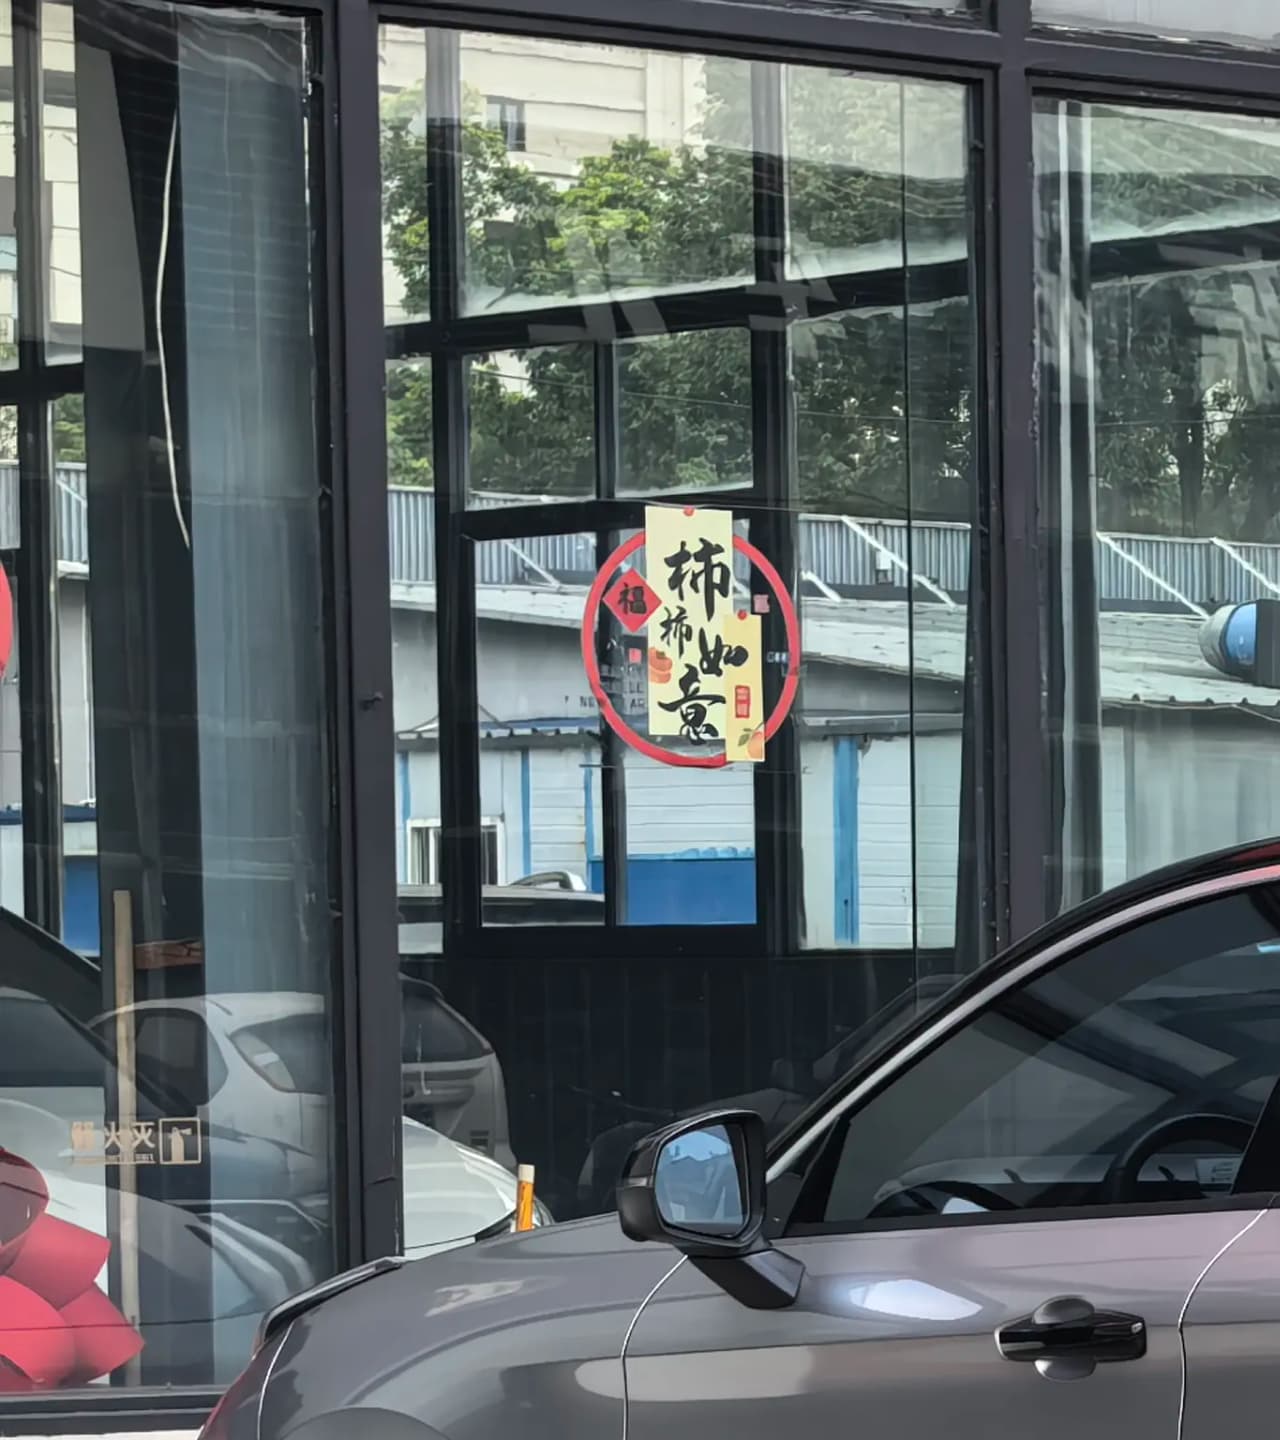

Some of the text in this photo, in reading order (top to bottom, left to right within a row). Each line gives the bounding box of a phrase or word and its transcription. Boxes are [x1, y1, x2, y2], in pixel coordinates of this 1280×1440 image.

[617, 583, 648, 616] 福
[658, 537, 749, 746] 柿柿如意
